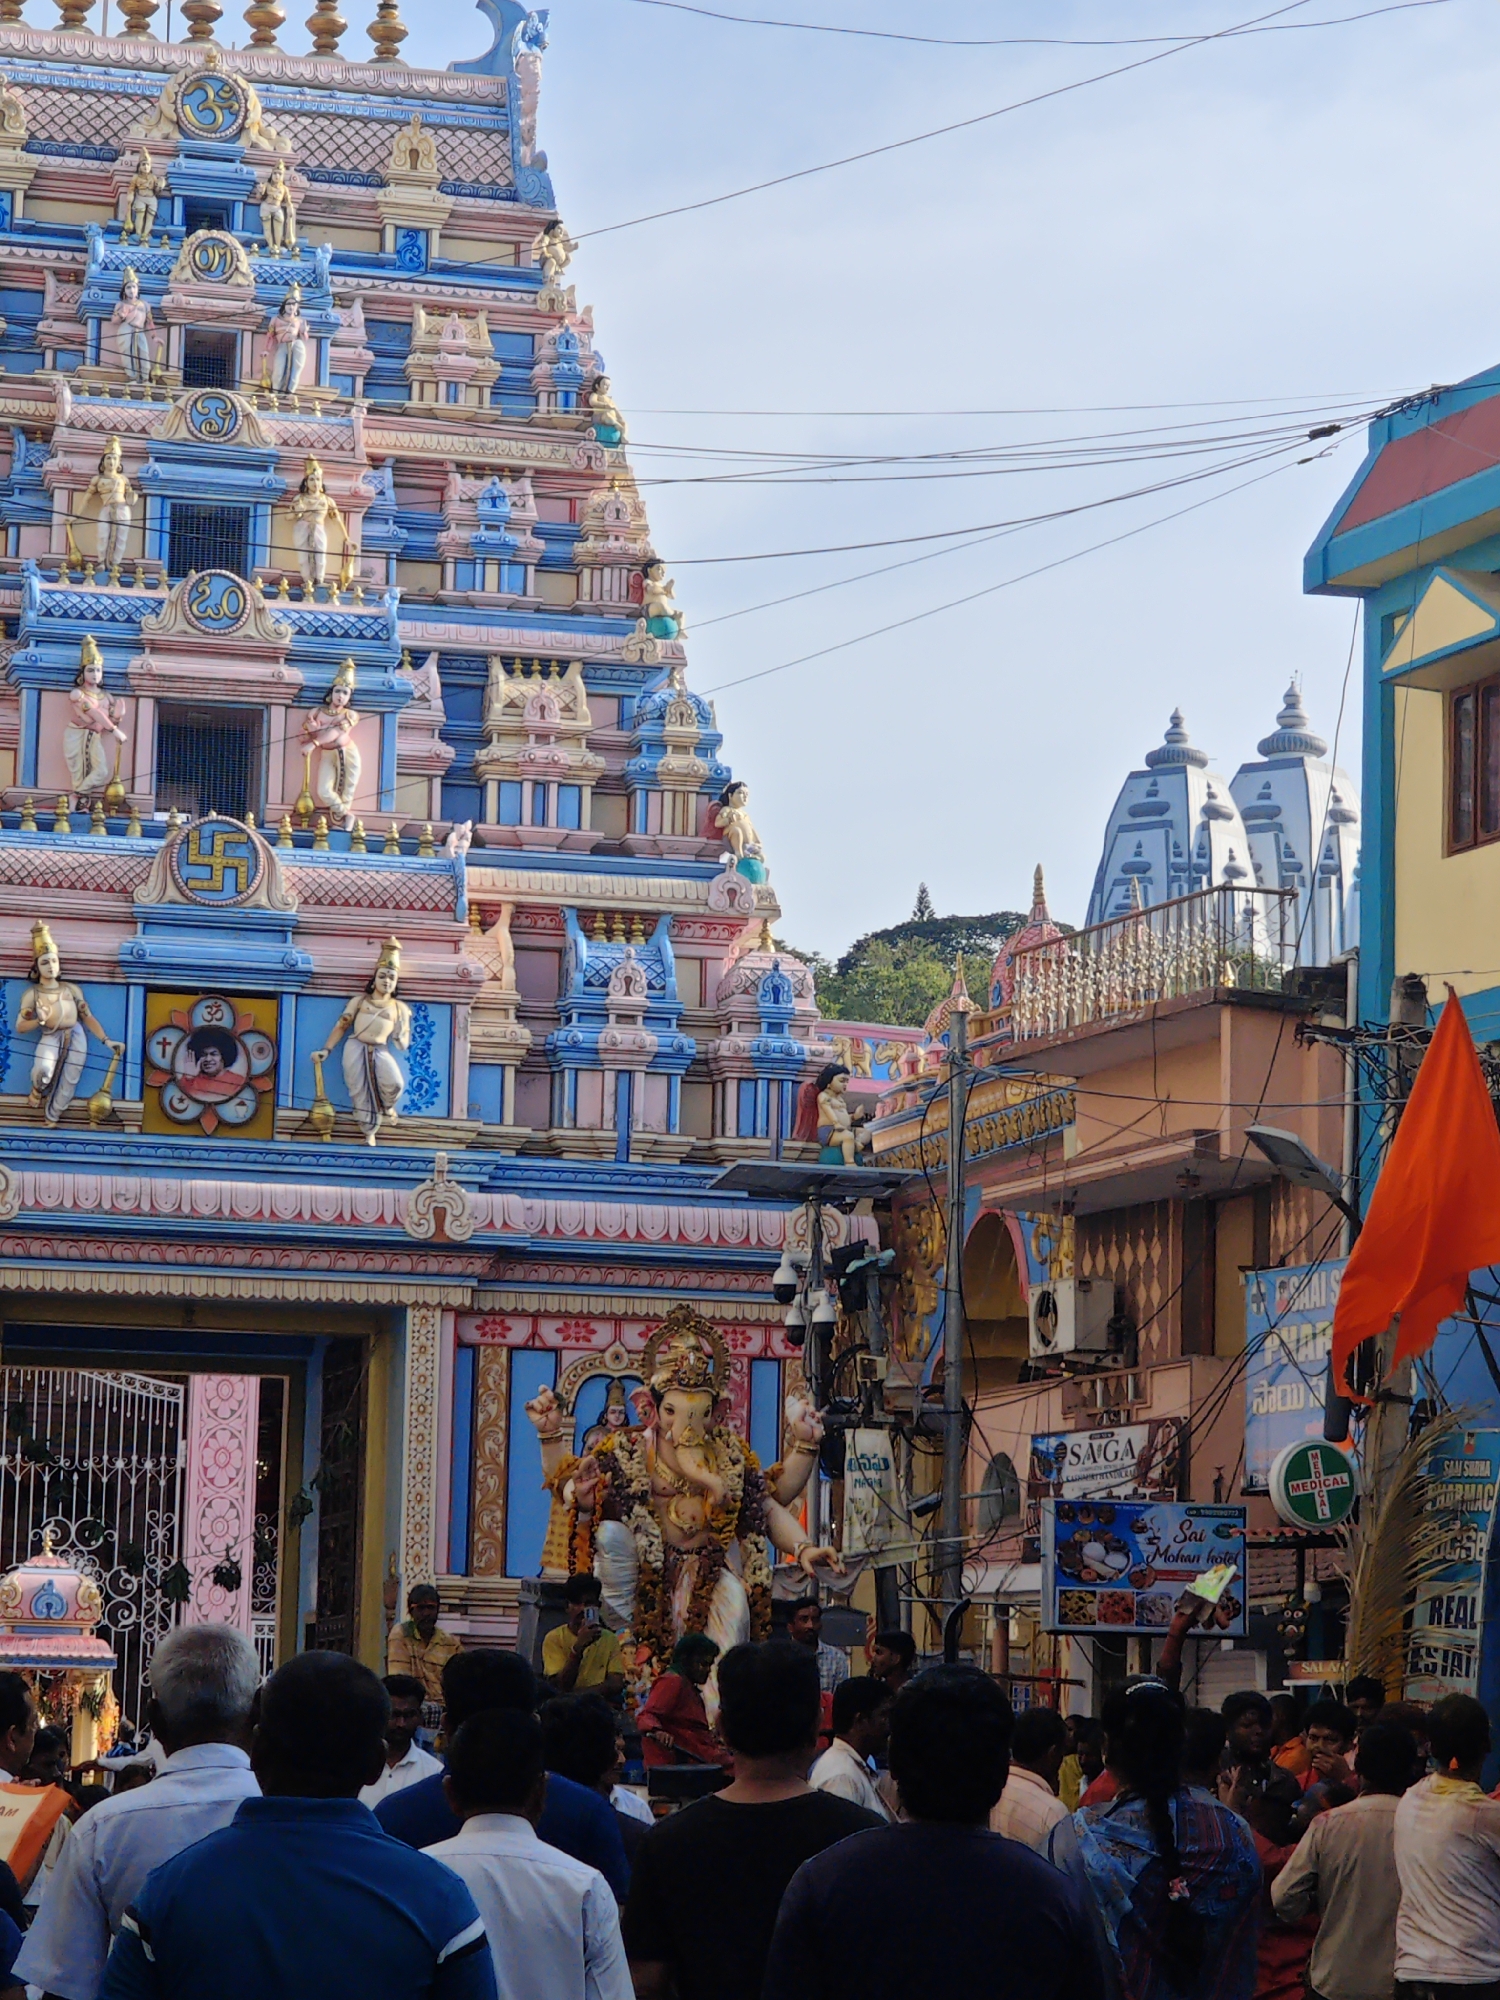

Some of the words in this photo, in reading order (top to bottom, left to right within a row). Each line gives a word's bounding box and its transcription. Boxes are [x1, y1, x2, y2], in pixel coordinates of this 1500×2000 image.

[195, 243, 232, 274] OM
[1287, 1271, 1328, 1314] SAAI
[1263, 1321, 1334, 1366] PHAR
[1068, 1437, 1137, 1467] SAGA
[1290, 1475, 1348, 1495] MEDICAL
[1310, 1452, 1327, 1517] MEDICAL
[1426, 1483, 1495, 1513] PHARMAC
[1173, 1518, 1207, 1543] Sai
[1146, 1544, 1201, 1565] Mohan
[1206, 1547, 1241, 1566] hotel
[1428, 1593, 1478, 1630] REAL
[1408, 1641, 1478, 1679] ESTAT
[0, 1805, 19, 1818] AM
